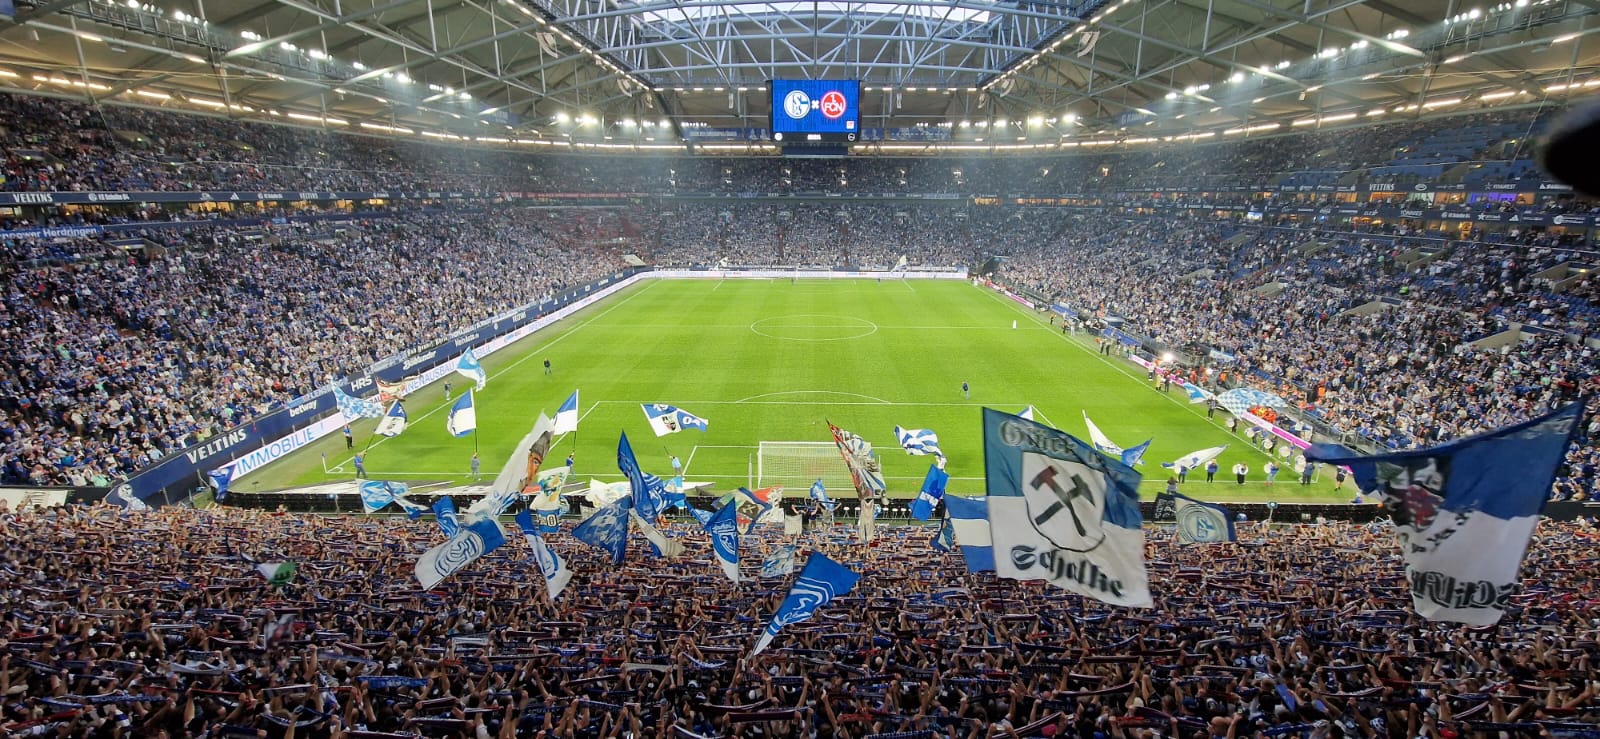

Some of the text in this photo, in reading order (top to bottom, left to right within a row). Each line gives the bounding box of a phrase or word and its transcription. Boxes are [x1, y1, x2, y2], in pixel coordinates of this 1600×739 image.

[824, 102, 843, 112] FCN
[1369, 183, 1396, 192] VELTINS
[12, 193, 54, 204] VELTINS
[350, 375, 373, 393] HRS
[289, 400, 317, 418] betway
[187, 428, 247, 465] VELTINS
[236, 428, 314, 475] IMMOBILIE
